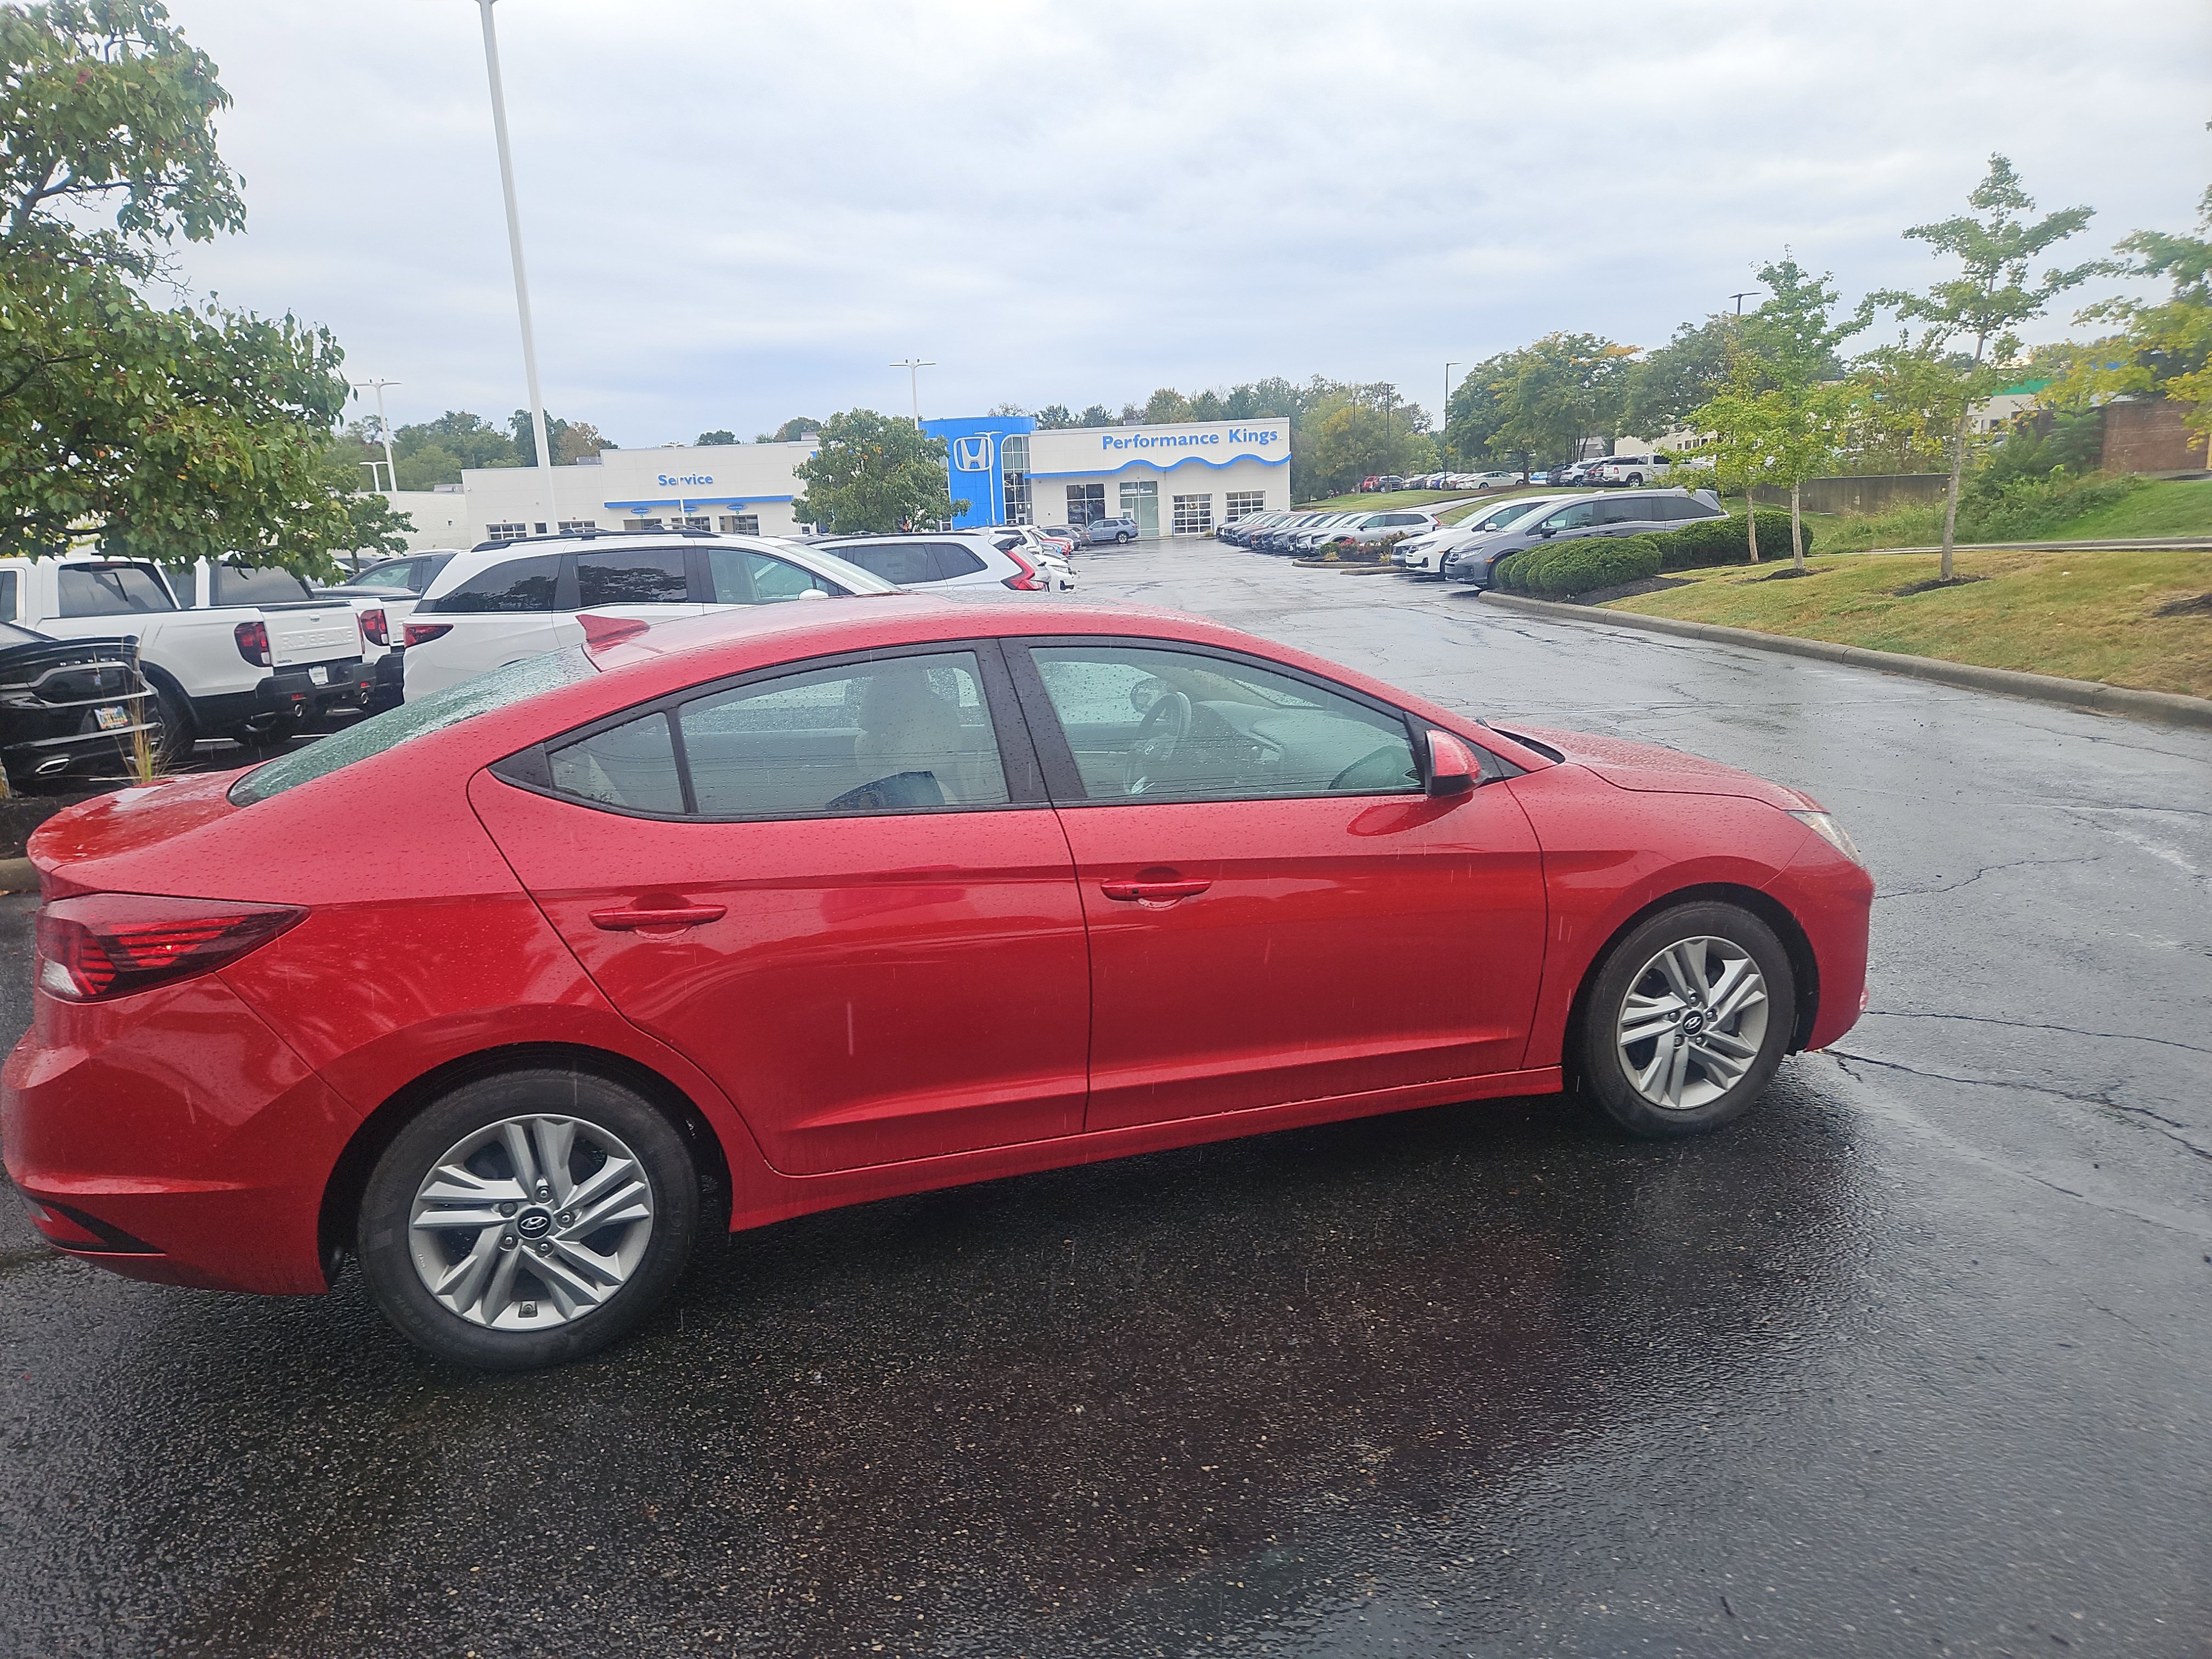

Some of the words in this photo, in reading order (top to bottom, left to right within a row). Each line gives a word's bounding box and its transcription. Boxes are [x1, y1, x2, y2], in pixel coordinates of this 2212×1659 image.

[1102, 433, 1220, 449] Performance
[1228, 428, 1278, 445] Kings
[658, 473, 713, 486] Service
